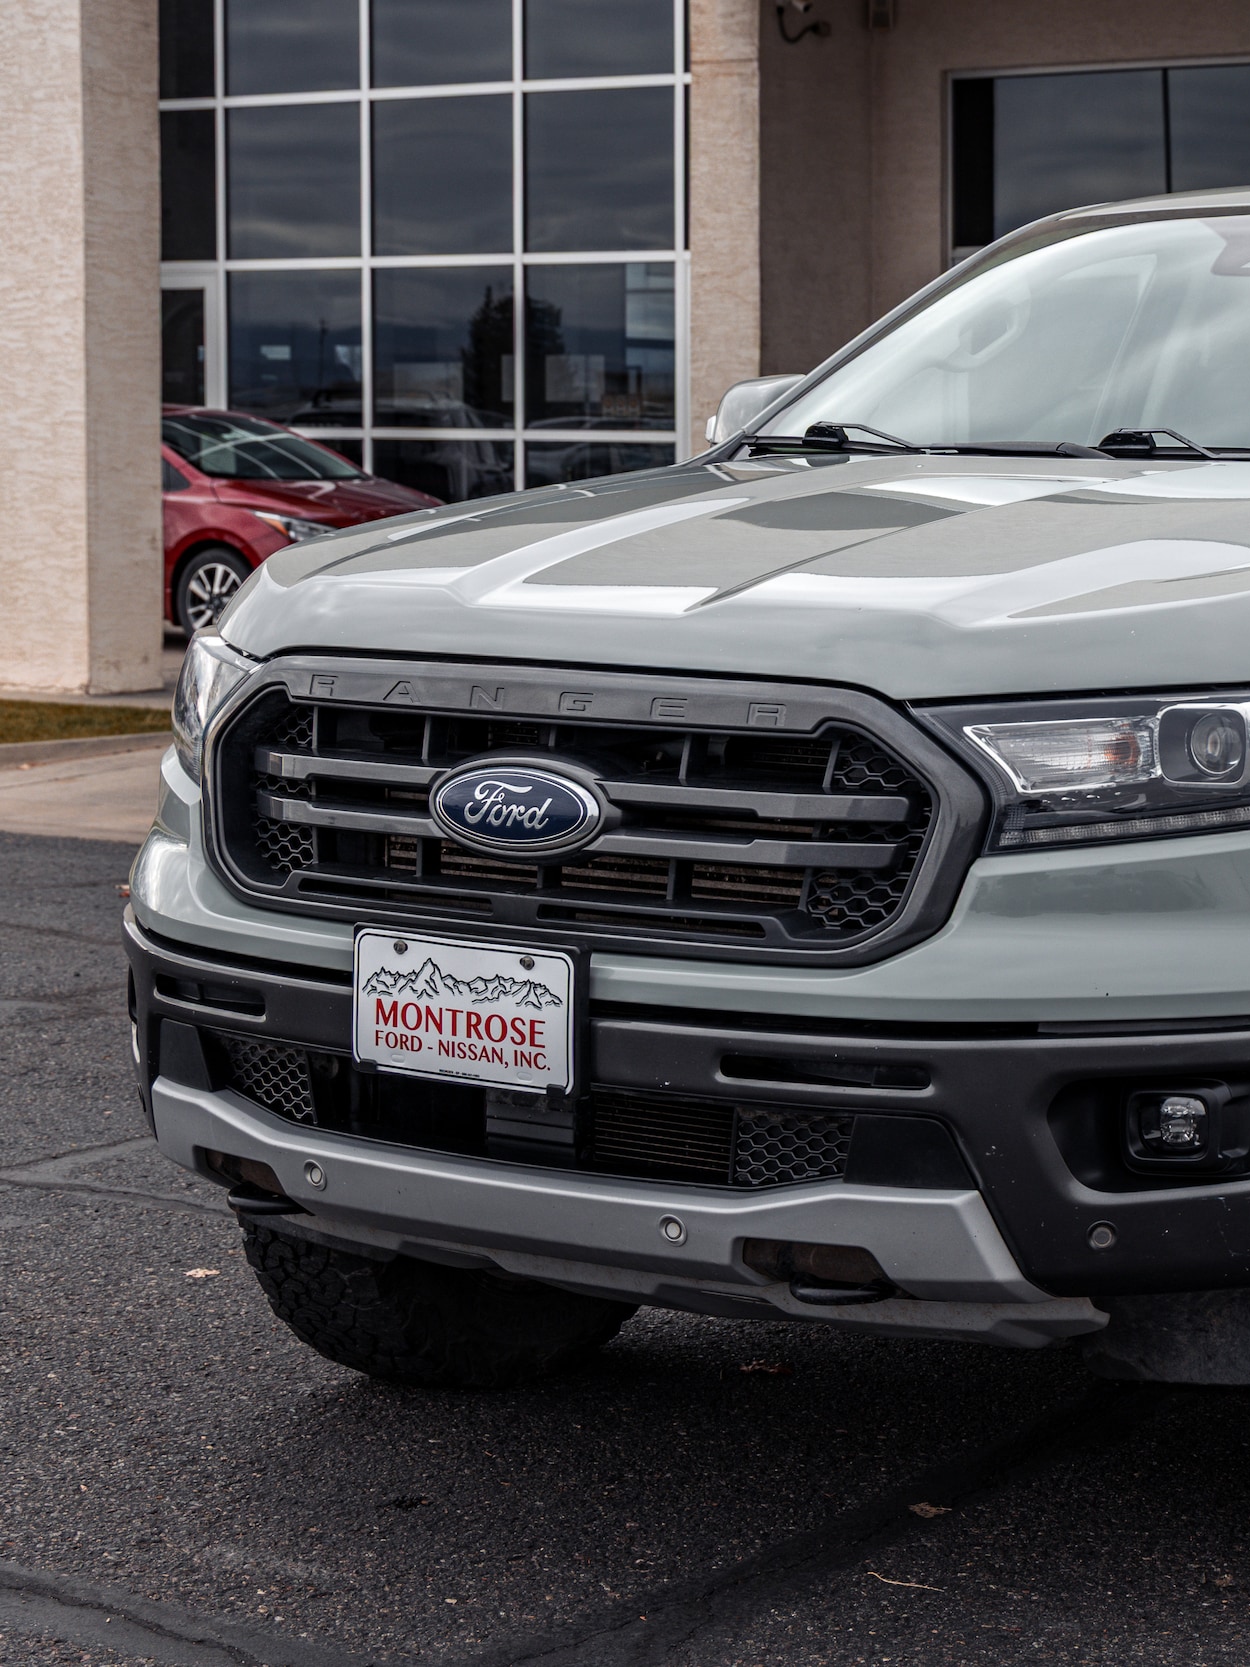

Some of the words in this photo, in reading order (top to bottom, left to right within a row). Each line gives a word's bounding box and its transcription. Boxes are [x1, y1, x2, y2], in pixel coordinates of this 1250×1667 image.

[309, 674, 788, 727] RANGER
[464, 780, 553, 830] Ford
[375, 998, 546, 1048] MONTROSE
[375, 1029, 423, 1052] FORD
[438, 1039, 508, 1068] NISSAN,
[513, 1050, 551, 1071] INC.
